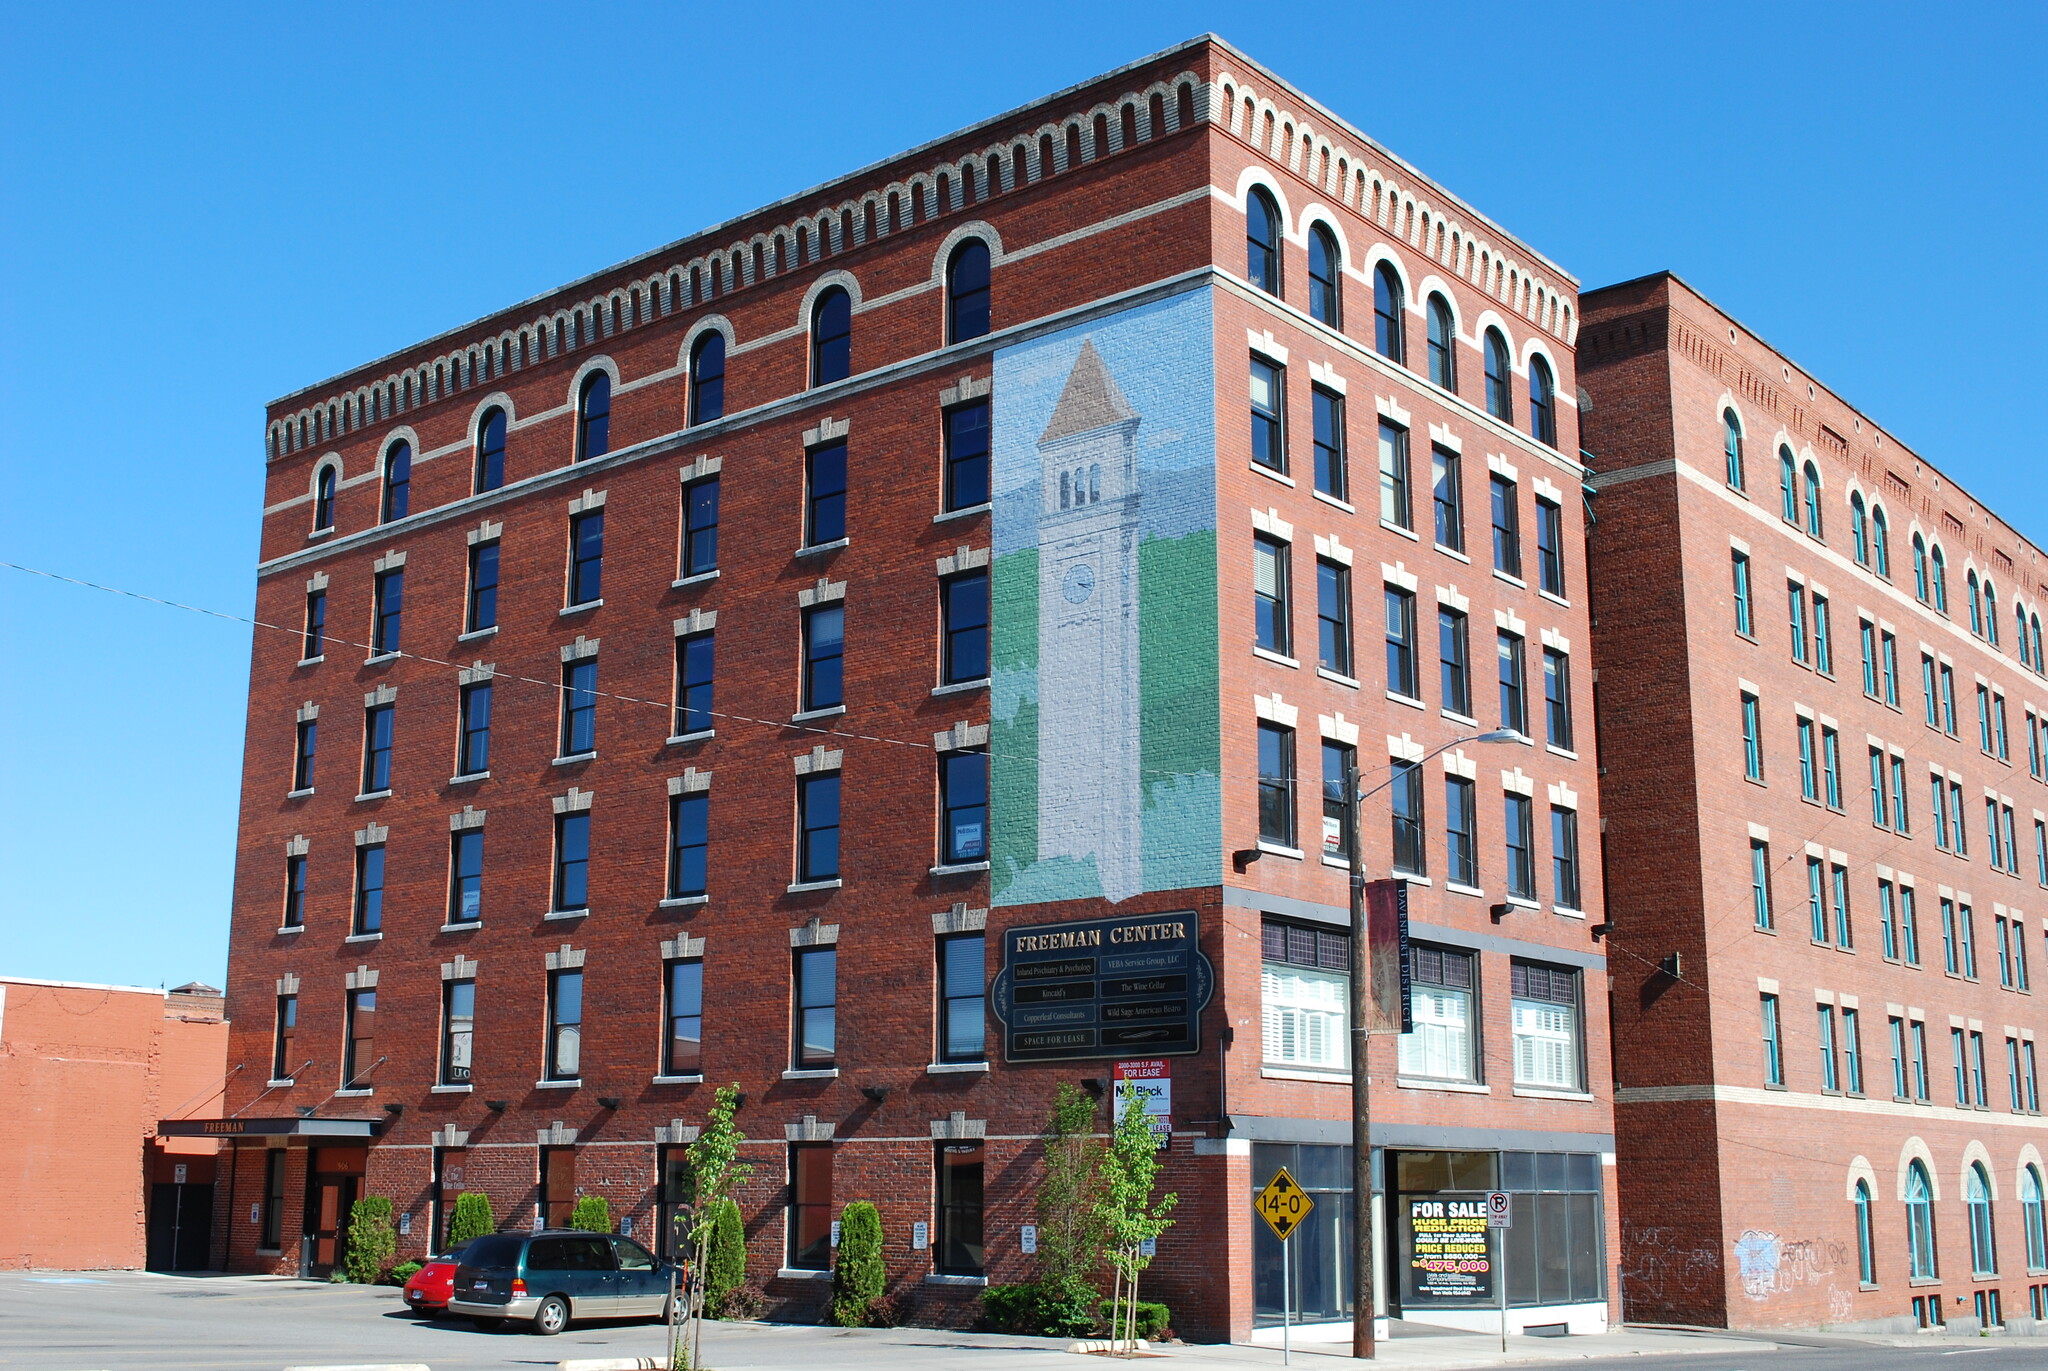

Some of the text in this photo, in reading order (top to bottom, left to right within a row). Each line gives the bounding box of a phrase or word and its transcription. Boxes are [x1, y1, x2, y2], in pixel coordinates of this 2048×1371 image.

[1016, 922, 1186, 953] FREEMAN CENTER
[1108, 955, 1180, 968] VEBA Service Group, LLC
[1398, 889, 1411, 1023] DAVENPORT DISTRICT
[1033, 966, 1058, 976] Psychiatry
[1064, 963, 1092, 973] Psychology
[1121, 981, 1166, 992] The Wine Cellar
[1042, 988, 1066, 998] Kincaid's
[1107, 1005, 1181, 1017] Wild Sage American Bistro
[1023, 1011, 1086, 1024] Copperleaf Consultants
[1024, 1034, 1085, 1046] SPACE FOR LEASE
[1138, 1068, 1161, 1077] LEASE
[204, 1121, 245, 1133] FREEMAN
[1152, 1124, 1170, 1132] LEASE
[1412, 1202, 1487, 1218] FOR SALE
[1415, 1244, 1486, 1253] PRICE REDUCED
[1420, 1258, 1489, 1273] $475,000
